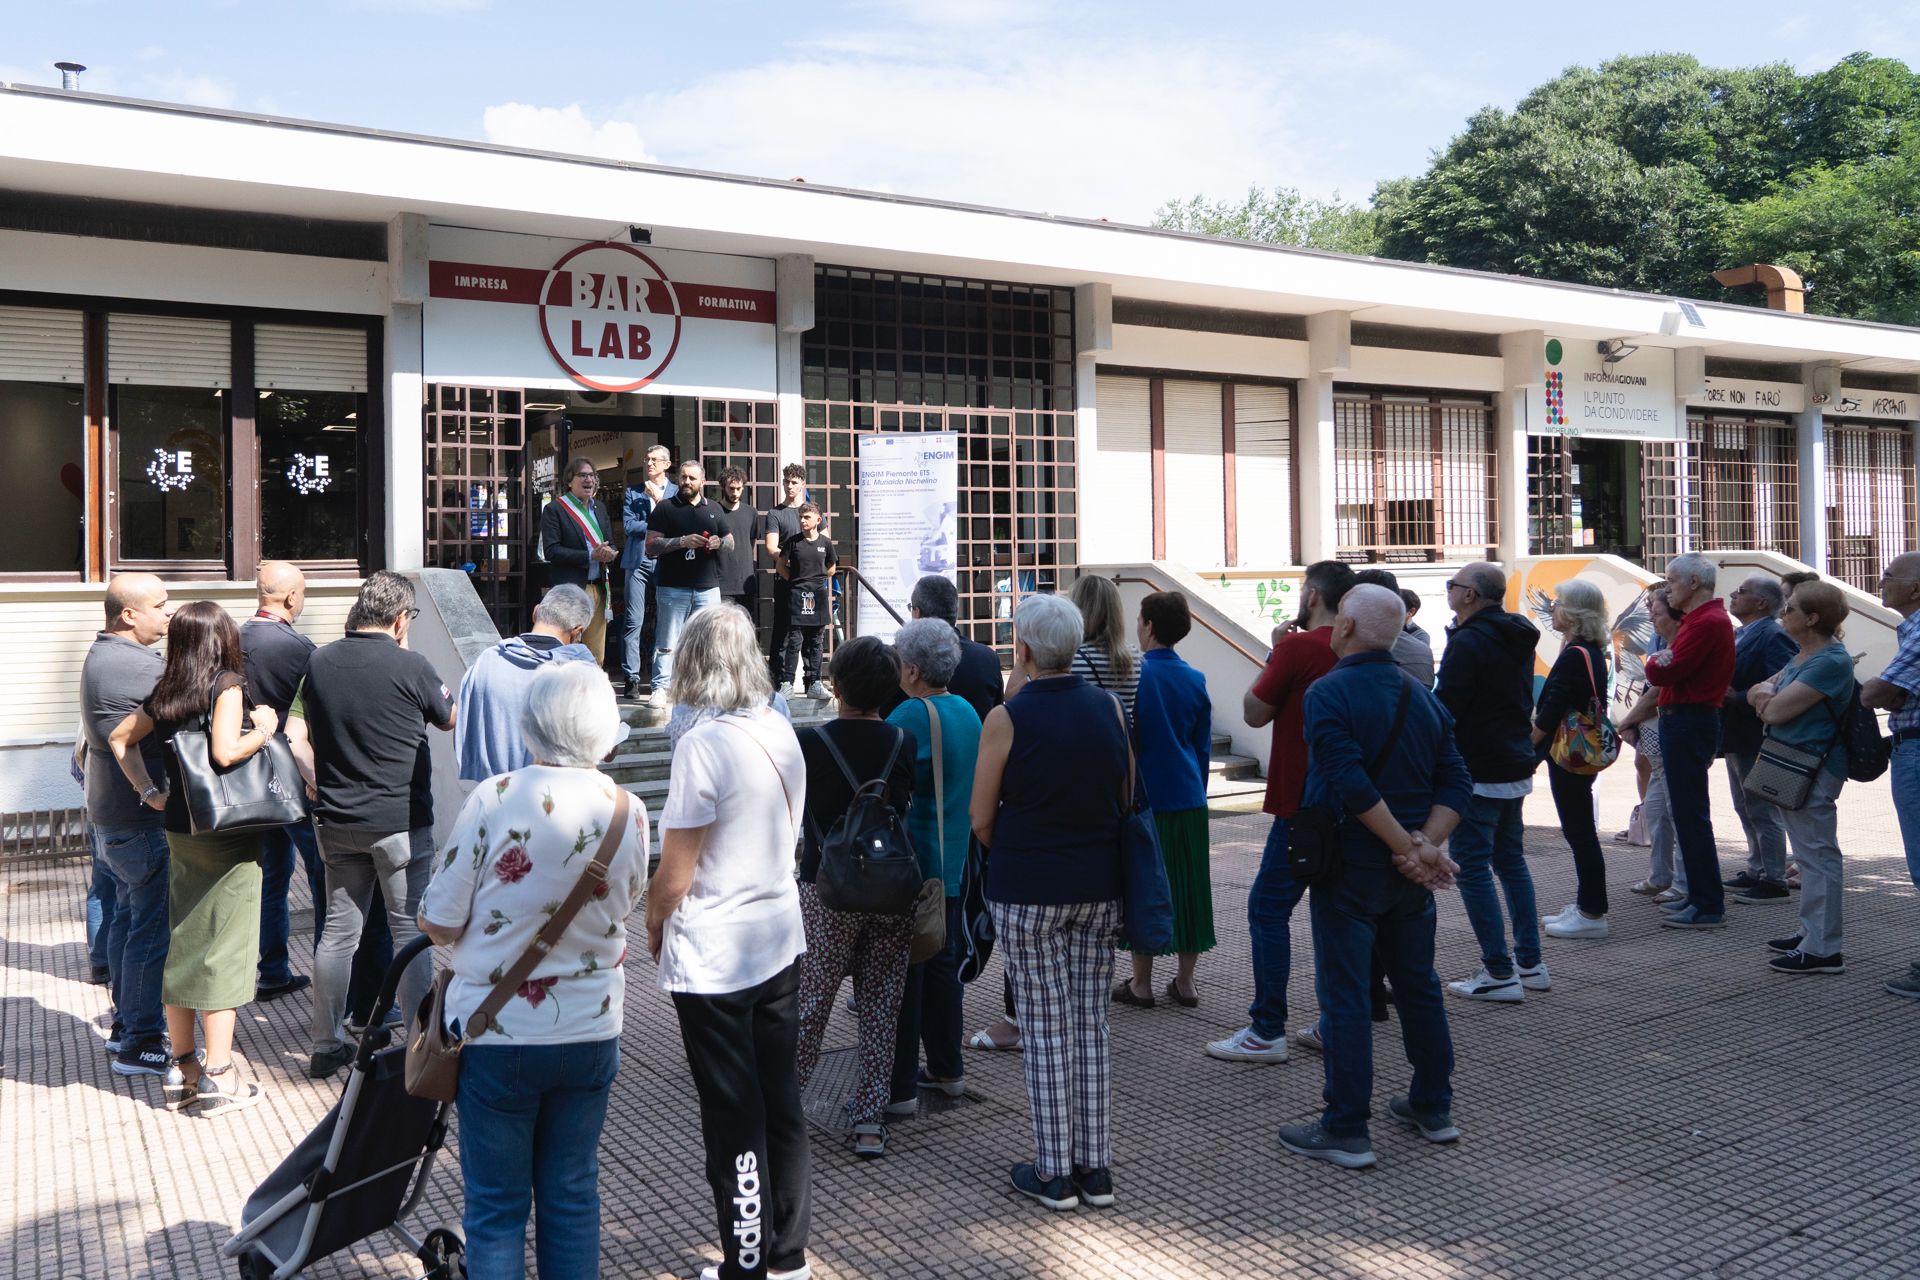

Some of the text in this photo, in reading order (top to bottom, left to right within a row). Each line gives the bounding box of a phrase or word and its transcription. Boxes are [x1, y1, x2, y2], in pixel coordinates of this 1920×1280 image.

[455, 275, 508, 290] IMPRESA
[571, 270, 653, 314] BAR
[698, 295, 757, 312] FORMATIVA
[571, 319, 652, 361] LAB
[1584, 372, 1647, 386] INFORMAGIOVANI
[1584, 391, 1625, 405] IL PUNTO
[1730, 389, 1745, 404] NON
[1584, 406, 1660, 421] DA CONDIVIDERE
[1545, 426, 1579, 436] NICHELINO
[923, 451, 955, 460] ENGIM
[861, 471, 884, 479] ENGIM
[886, 470, 918, 478] Piemonte
[873, 478, 904, 486] Murialdo
[905, 477, 938, 485] Nichelino
[139, 1051, 166, 1063] HOKA
[733, 1150, 762, 1269] adidas
